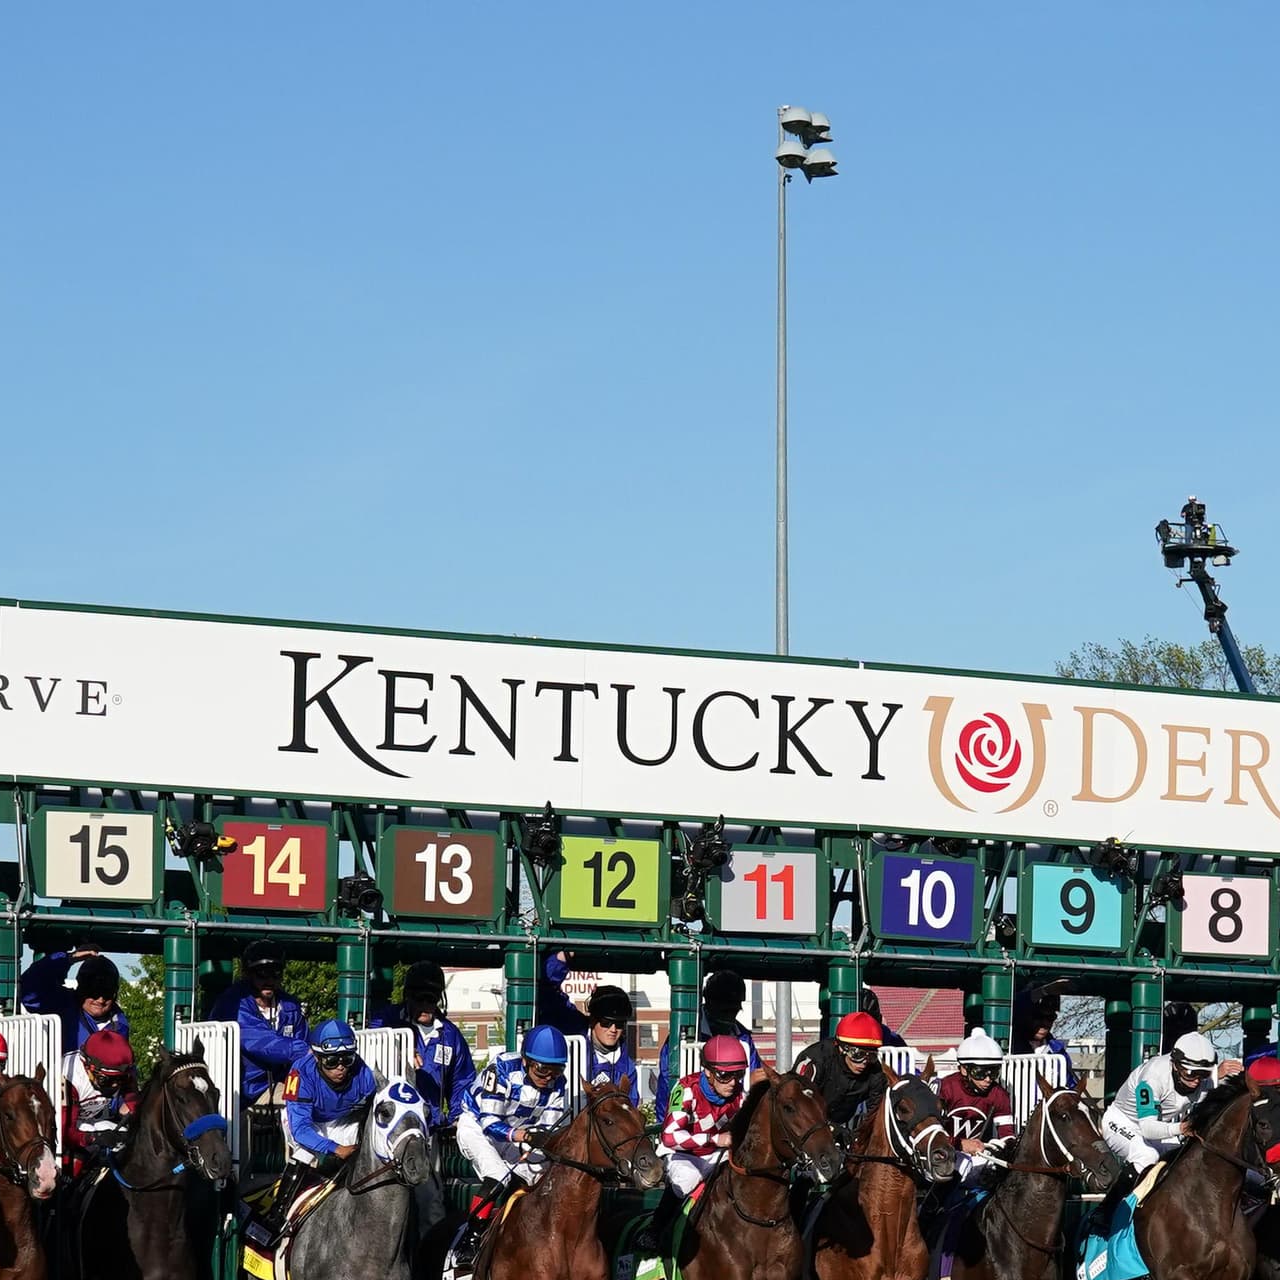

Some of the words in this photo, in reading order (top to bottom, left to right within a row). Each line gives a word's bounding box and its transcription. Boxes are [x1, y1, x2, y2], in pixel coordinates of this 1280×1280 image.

[277, 650, 904, 781] KENTUCKY
[69, 825, 129, 885] 15
[243, 836, 306, 896] 14
[416, 843, 473, 904] 13
[583, 851, 636, 909] 12
[743, 864, 796, 921] 11
[900, 869, 955, 929] 10
[1060, 878, 1095, 934] 9
[1209, 888, 1243, 943] 8
[564, 983, 597, 994] DIUM
[566, 971, 603, 980] DINAL
[285, 1075, 299, 1096] 14
[481, 1069, 496, 1093] 13
[1140, 1089, 1149, 1106] 9
[951, 1116, 984, 1139] W
